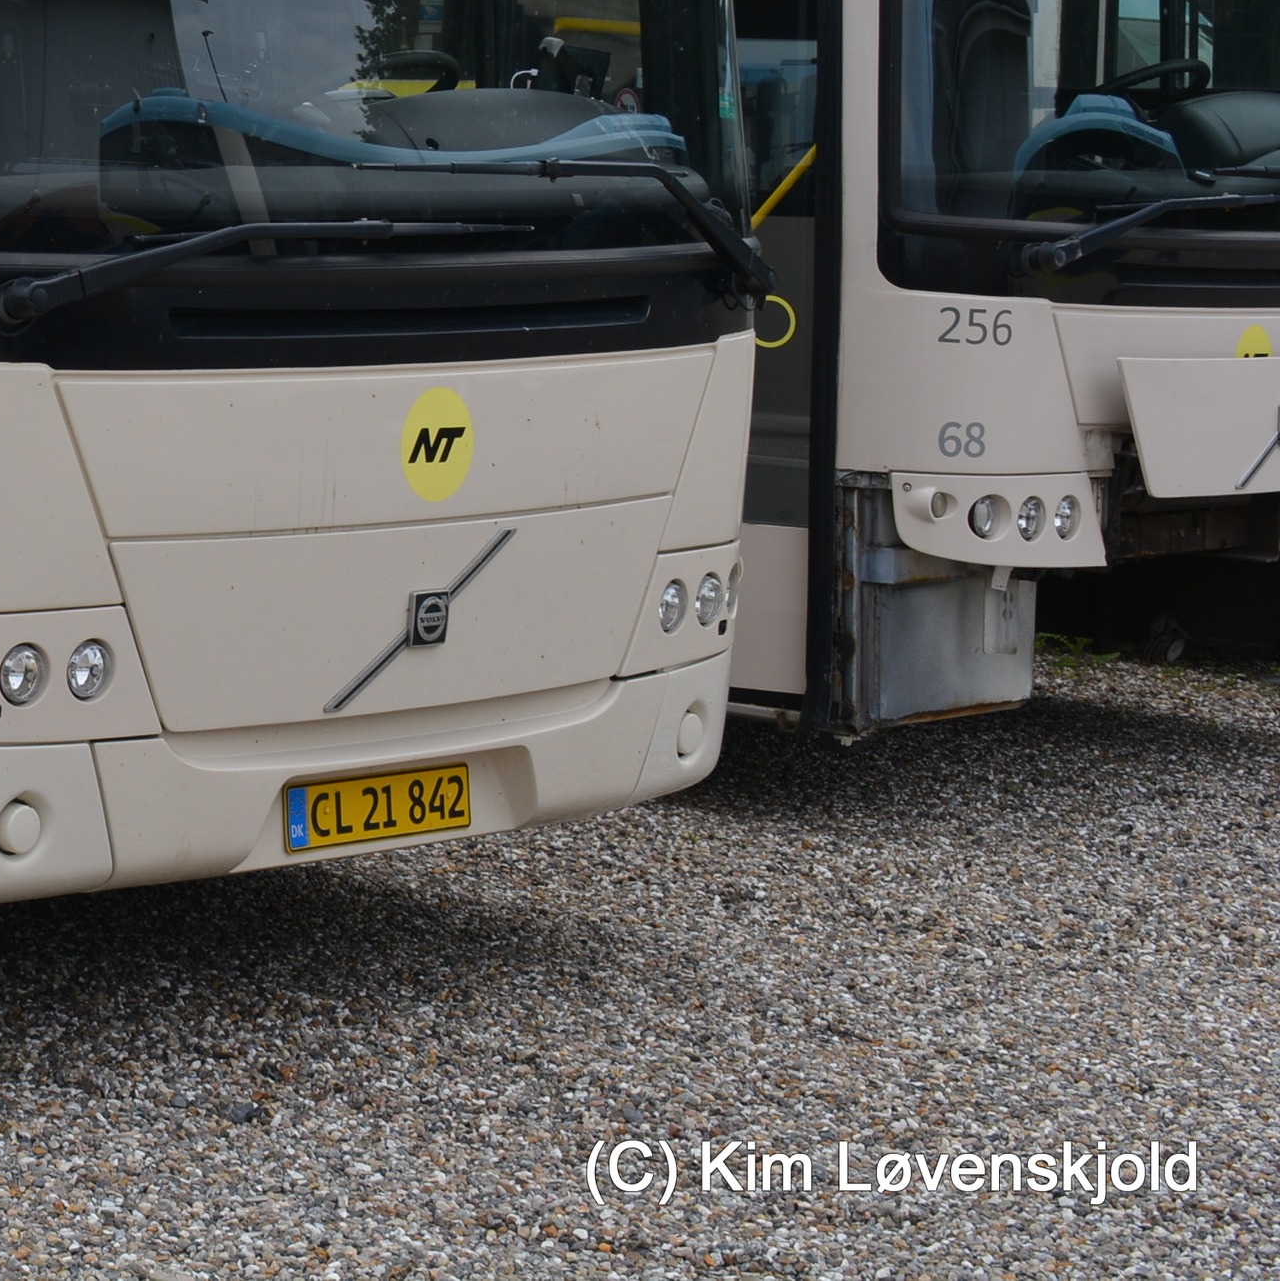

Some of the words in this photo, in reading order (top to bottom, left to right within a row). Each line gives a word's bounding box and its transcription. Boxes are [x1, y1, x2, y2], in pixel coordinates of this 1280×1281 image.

[937, 306, 1013, 346] 256
[407, 426, 466, 465] NT
[939, 421, 986, 458] 68
[419, 615, 446, 624] VOLVO
[311, 791, 354, 838] CL
[362, 784, 397, 831] 21
[408, 775, 465, 825] 842
[291, 823, 304, 838] DK
